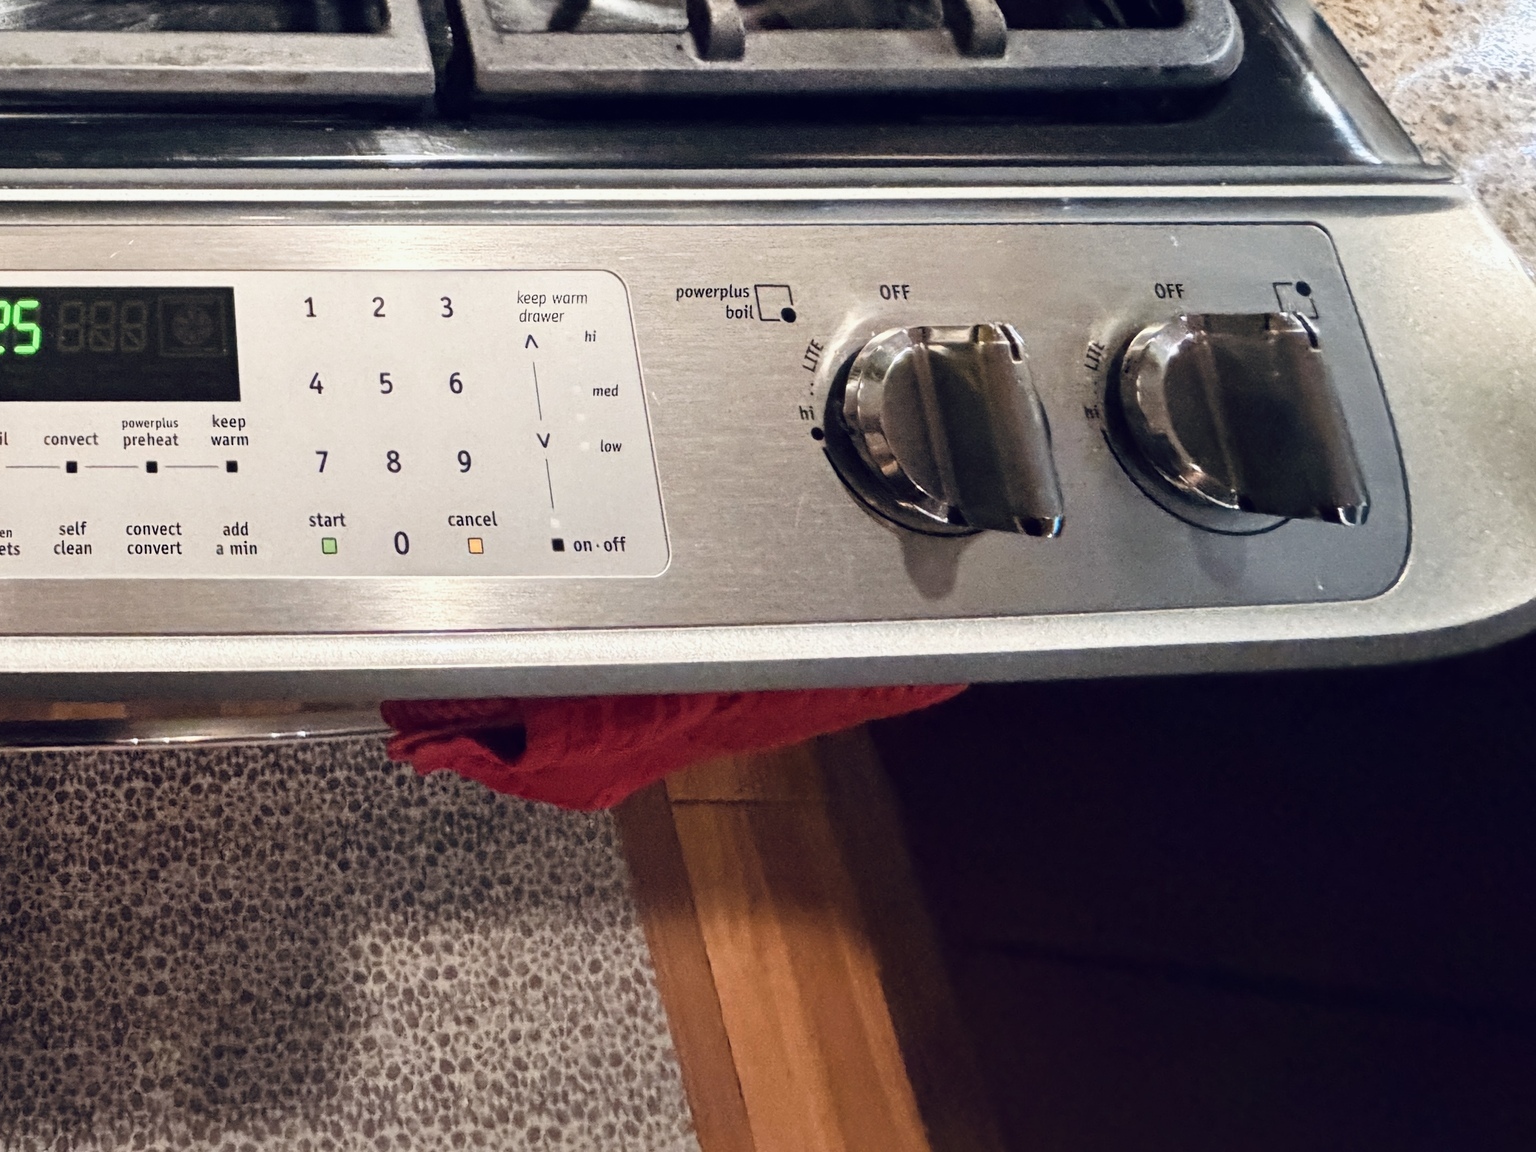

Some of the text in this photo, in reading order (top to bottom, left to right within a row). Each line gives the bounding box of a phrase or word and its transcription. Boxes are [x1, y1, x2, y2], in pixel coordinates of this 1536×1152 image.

[516, 290, 588, 307] keep warm
[676, 283, 750, 302] powerplus
[879, 284, 910, 301] OFF
[1154, 282, 1185, 299] OFF
[304, 296, 317, 318] 1
[372, 296, 386, 318] 2
[440, 296, 454, 319] 3
[725, 304, 755, 320] boil
[519, 309, 565, 323] drawer
[584, 330, 597, 342] hi
[802, 338, 824, 373] LITE
[309, 372, 324, 395] 4
[379, 372, 394, 395] 5
[449, 371, 464, 395] 6
[592, 384, 619, 397] med
[798, 405, 815, 421] hi
[121, 417, 179, 431] powerplus
[212, 414, 246, 432] keep
[43, 432, 99, 446] convect
[123, 432, 179, 449] preheat
[210, 435, 249, 446] warm
[600, 439, 622, 453] low
[315, 450, 329, 473] 7
[386, 449, 402, 474] 8
[457, 449, 472, 474] 9
[308, 512, 347, 528] start
[447, 510, 498, 527] cancel
[58, 520, 88, 536] self
[125, 522, 183, 536] convect
[222, 521, 249, 537] add
[53, 540, 92, 556] clean
[127, 541, 183, 555] convert
[215, 540, 258, 556] a min
[393, 530, 410, 556] 0
